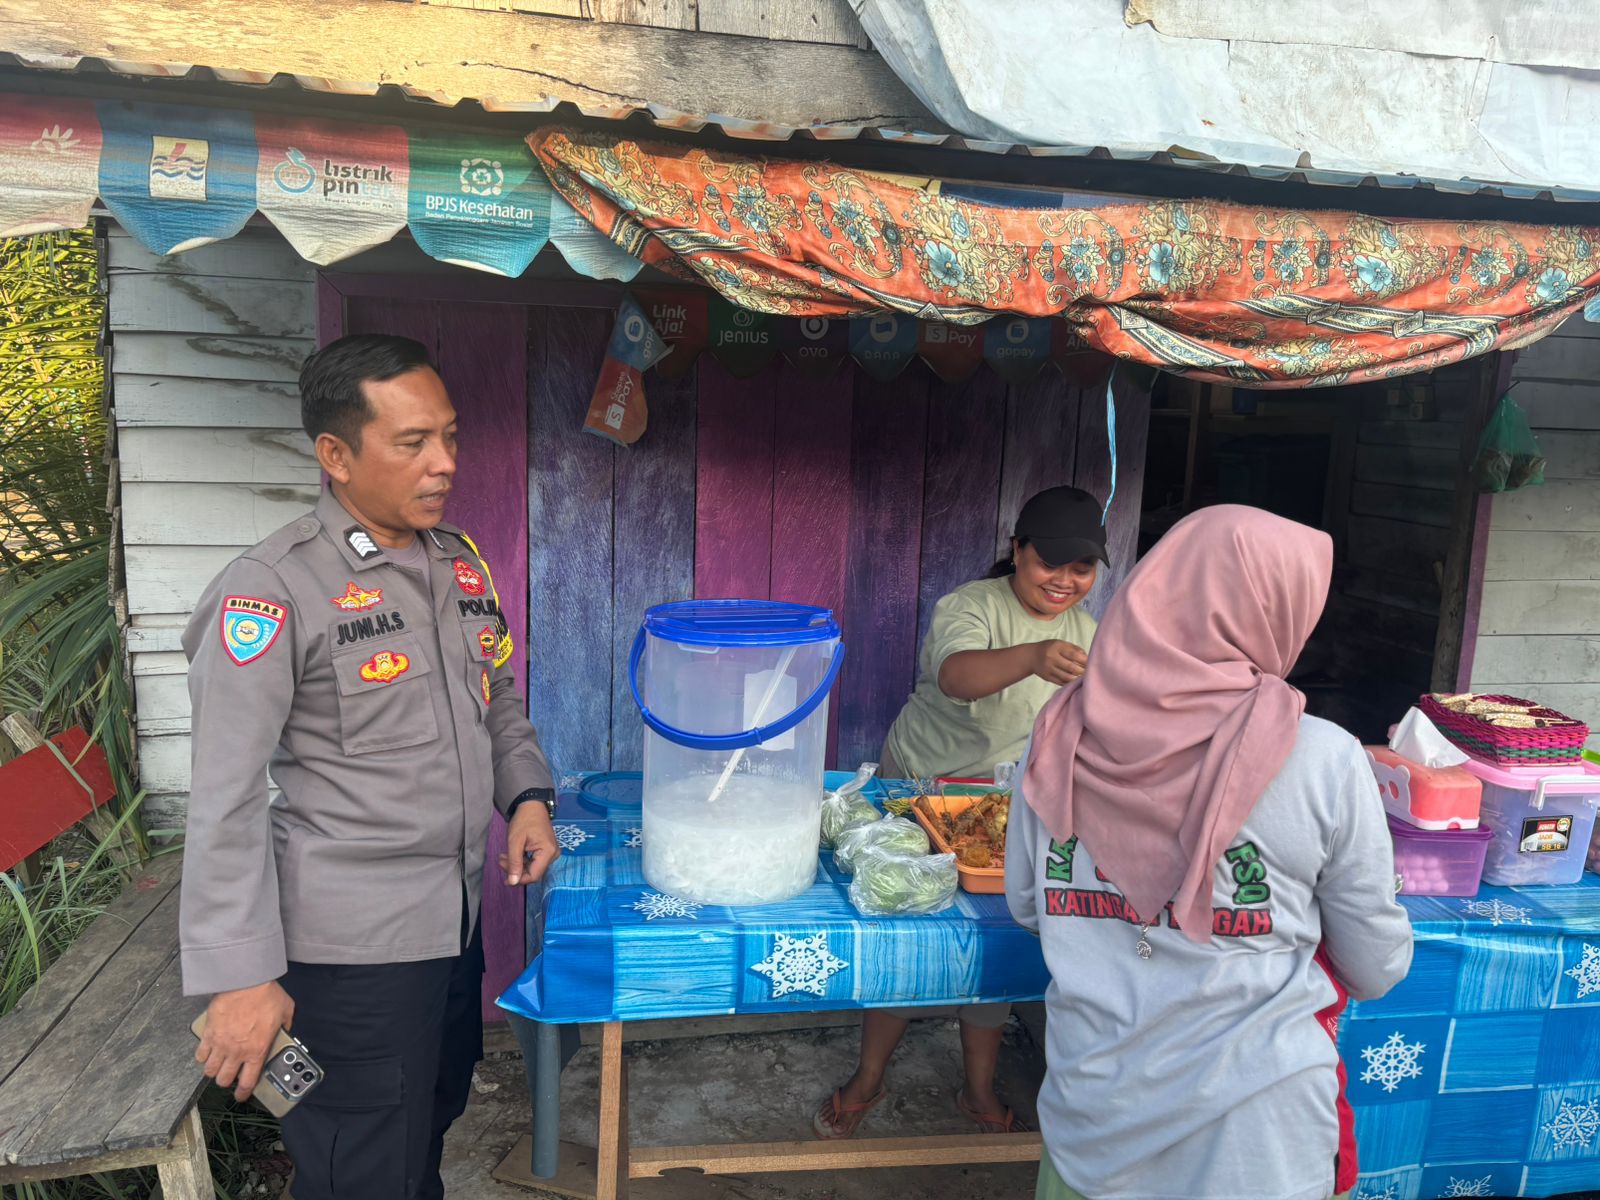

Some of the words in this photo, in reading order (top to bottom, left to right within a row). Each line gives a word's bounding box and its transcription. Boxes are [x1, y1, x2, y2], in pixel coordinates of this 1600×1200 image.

[425, 195, 458, 212] BPJS
[459, 199, 533, 220] Kesehatan
[653, 304, 687, 321] Link
[655, 318, 684, 336] Aja!
[948, 330, 977, 348] Pay
[643, 324, 655, 359] gop
[996, 346, 1036, 360] gopay
[618, 375, 634, 406] Pay
[230, 599, 279, 616] BINMAS
[337, 611, 405, 645] JUNI.H.S
[1224, 841, 1271, 906] FSQ
[1044, 887, 1160, 927] KATINGA
